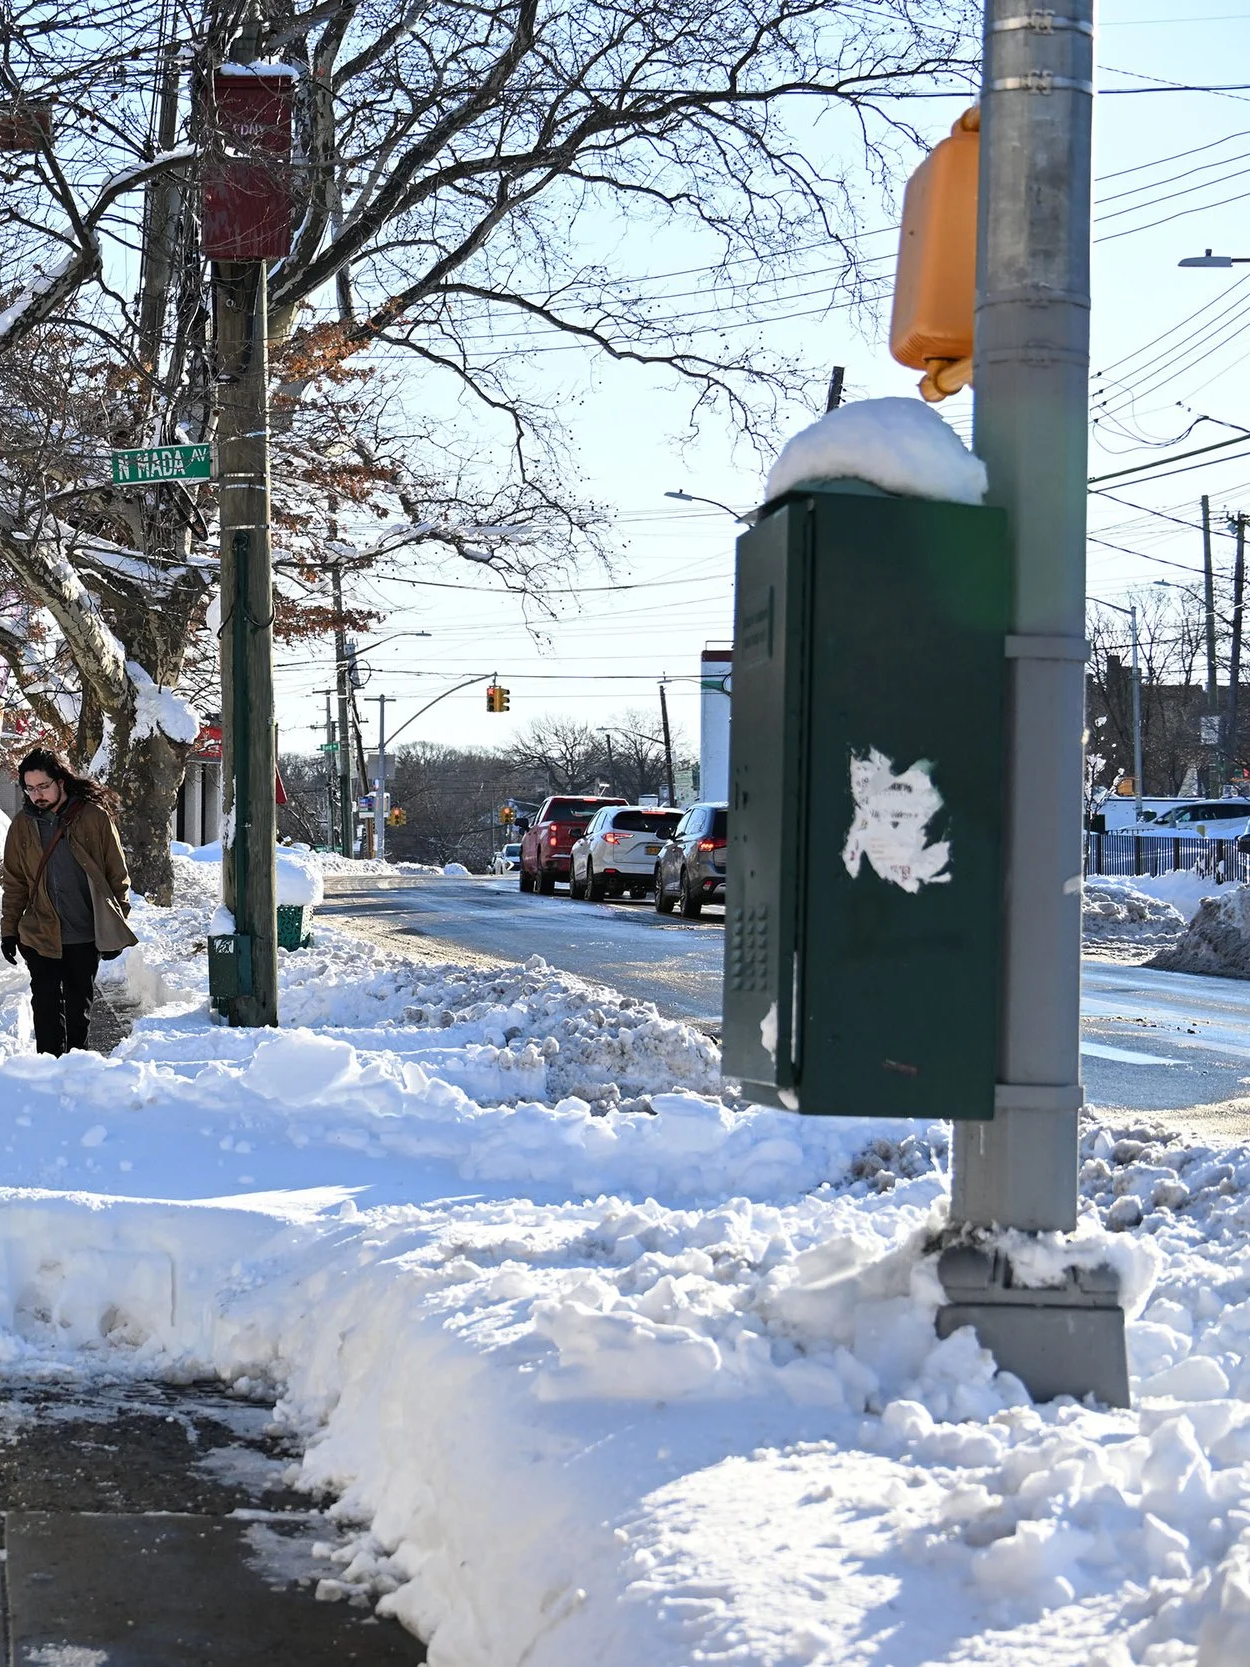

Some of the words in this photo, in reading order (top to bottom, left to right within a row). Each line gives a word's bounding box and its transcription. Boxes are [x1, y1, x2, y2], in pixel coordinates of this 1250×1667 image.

[117, 454, 130, 481] N
[137, 449, 186, 479] MADA
[190, 447, 207, 463] AV
